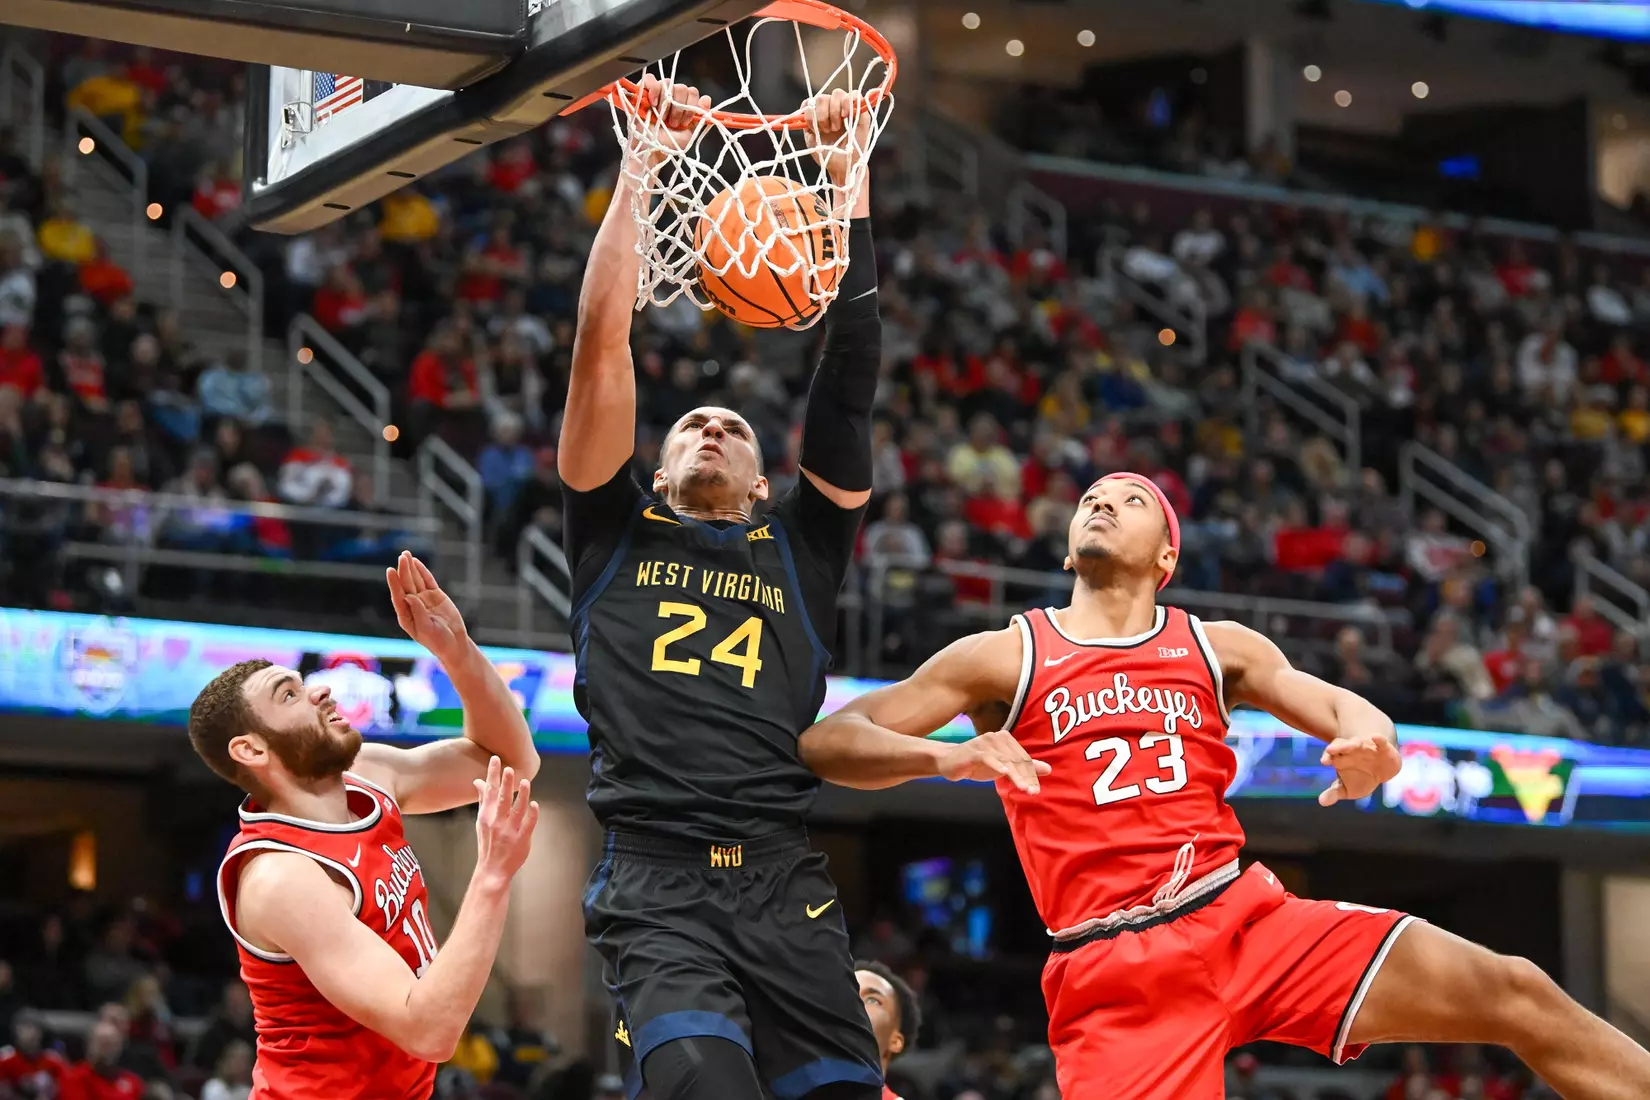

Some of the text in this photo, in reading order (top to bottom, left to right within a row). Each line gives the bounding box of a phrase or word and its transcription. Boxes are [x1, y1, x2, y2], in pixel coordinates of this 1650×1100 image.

[636, 561, 785, 615] WEST VIRGINIA
[651, 601, 763, 689] 24
[1044, 672, 1202, 744] Buckeyes
[1084, 731, 1189, 806] 23
[374, 843, 426, 933] Buckey
[710, 844, 742, 868] WVU
[402, 897, 438, 979] 10
